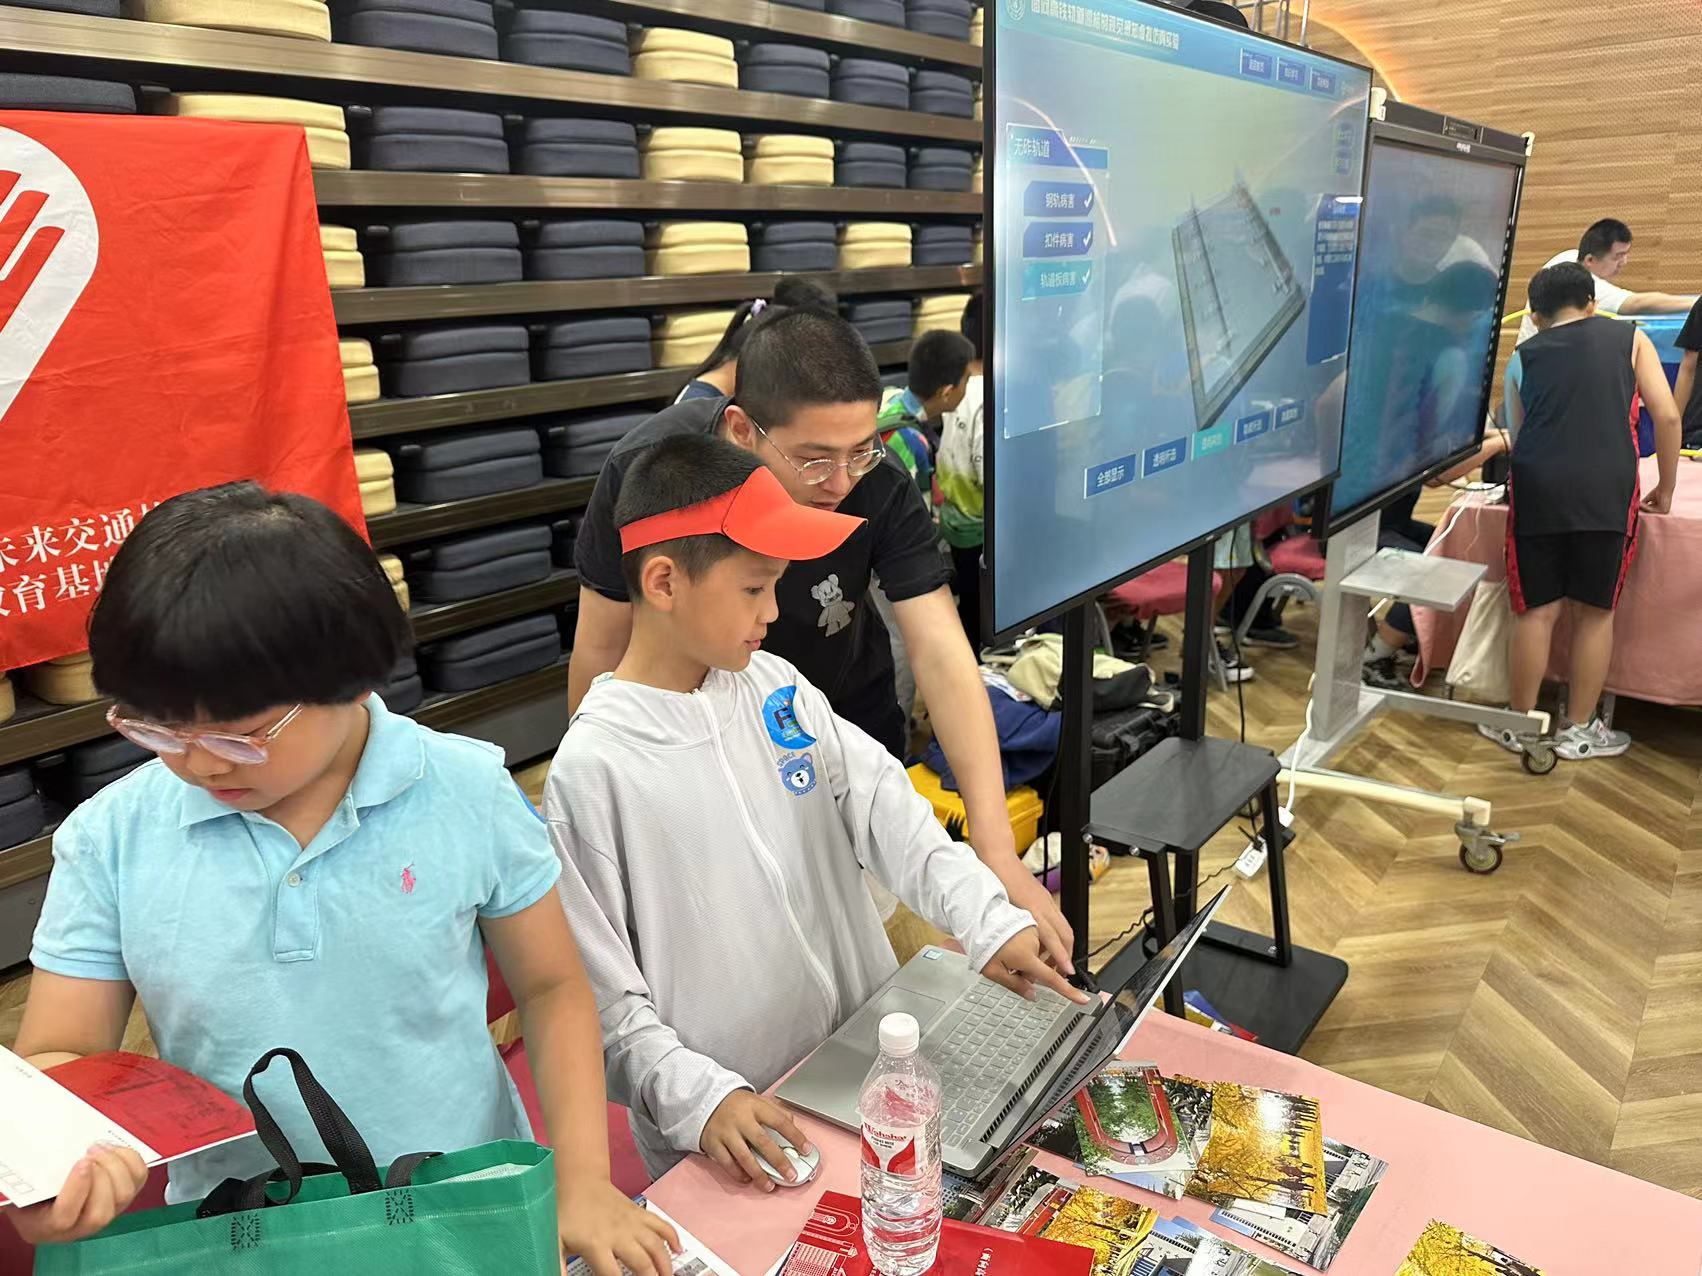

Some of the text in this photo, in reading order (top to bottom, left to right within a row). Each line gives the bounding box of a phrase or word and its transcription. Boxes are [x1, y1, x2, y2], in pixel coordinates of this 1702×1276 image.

[1044, 233, 1074, 248] 扣件病害
[1097, 465, 1125, 487] 全部显示
[0, 501, 160, 574] 来交通
